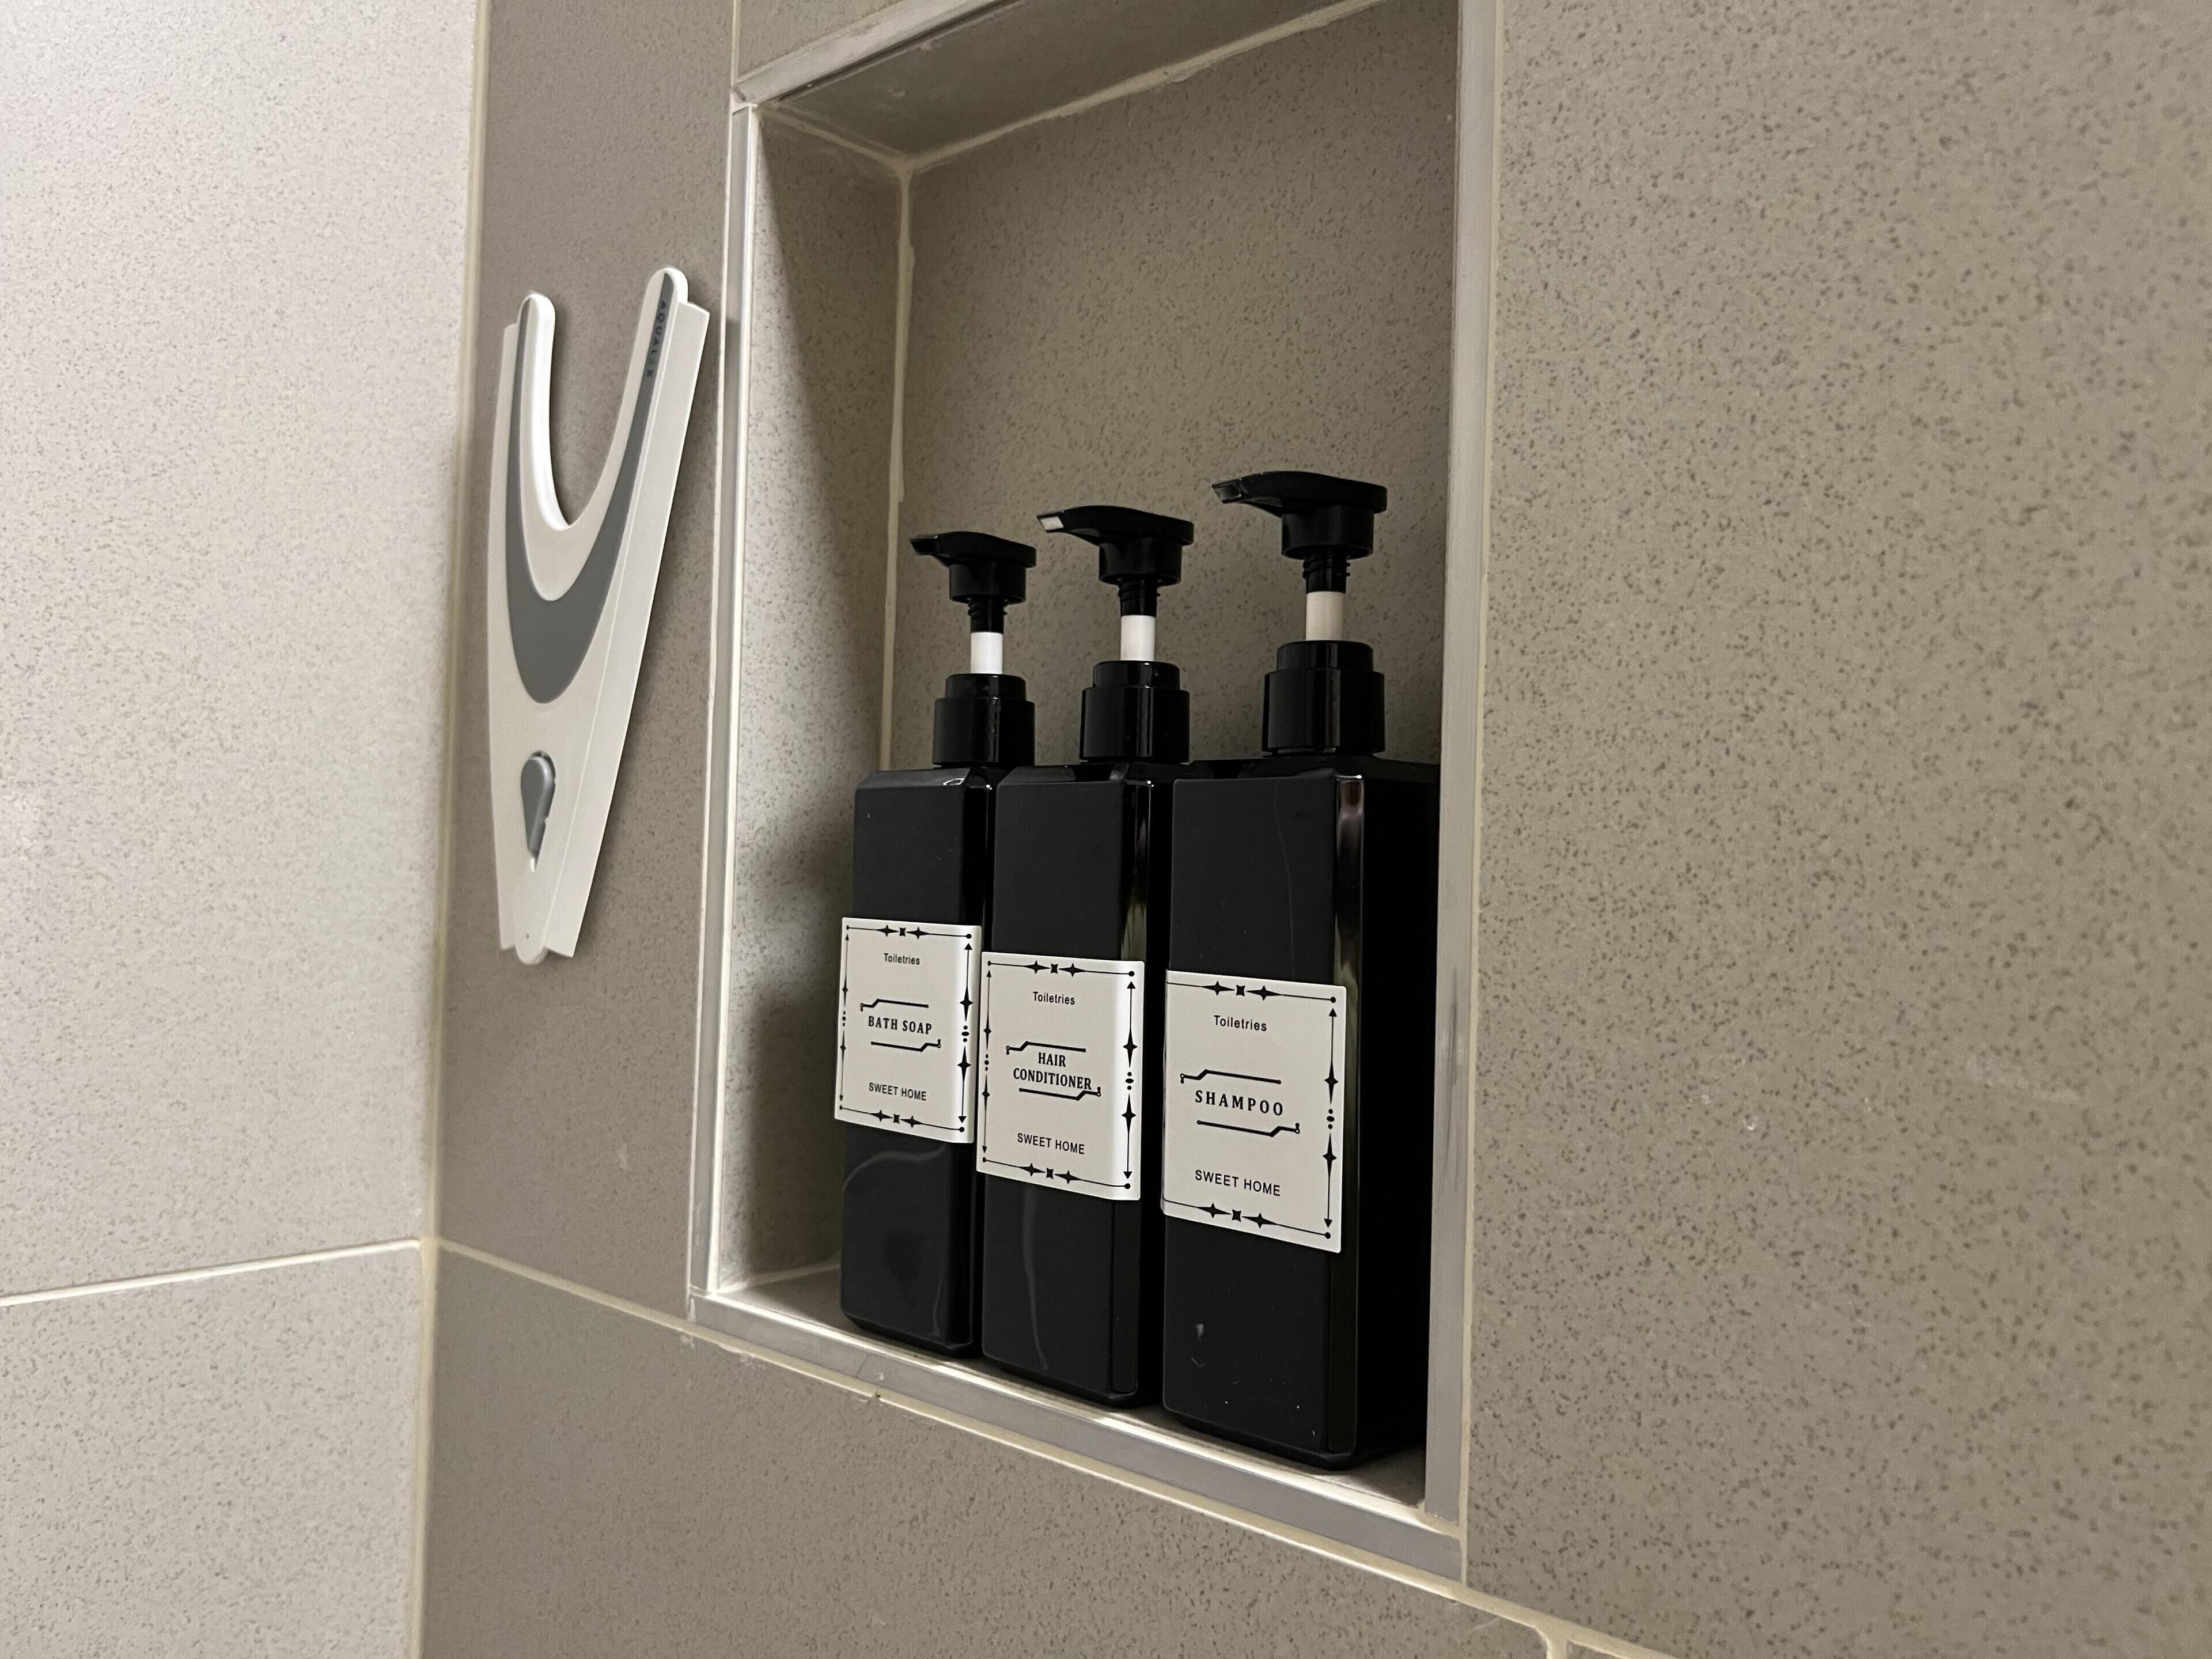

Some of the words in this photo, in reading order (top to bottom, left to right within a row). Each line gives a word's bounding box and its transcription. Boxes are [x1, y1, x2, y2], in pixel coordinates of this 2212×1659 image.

[884, 953, 920, 965] Toiletries
[1032, 991, 1075, 1005] Toiletries
[868, 1015, 898, 1031] BATH
[902, 1020, 932, 1035] SOAP
[1213, 1014, 1267, 1032] Toiletries
[1038, 1052, 1066, 1067] HAIR
[1013, 1067, 1092, 1090] CONDITIONER
[869, 1082, 899, 1096] SWEET
[901, 1088, 927, 1101] HOME
[1195, 1090, 1283, 1116] SHAMPOO
[1017, 1132, 1052, 1148] SWEET
[1055, 1139, 1085, 1155] HOME
[1195, 1169, 1239, 1188] SWEET
[1244, 1178, 1281, 1196] HOME
